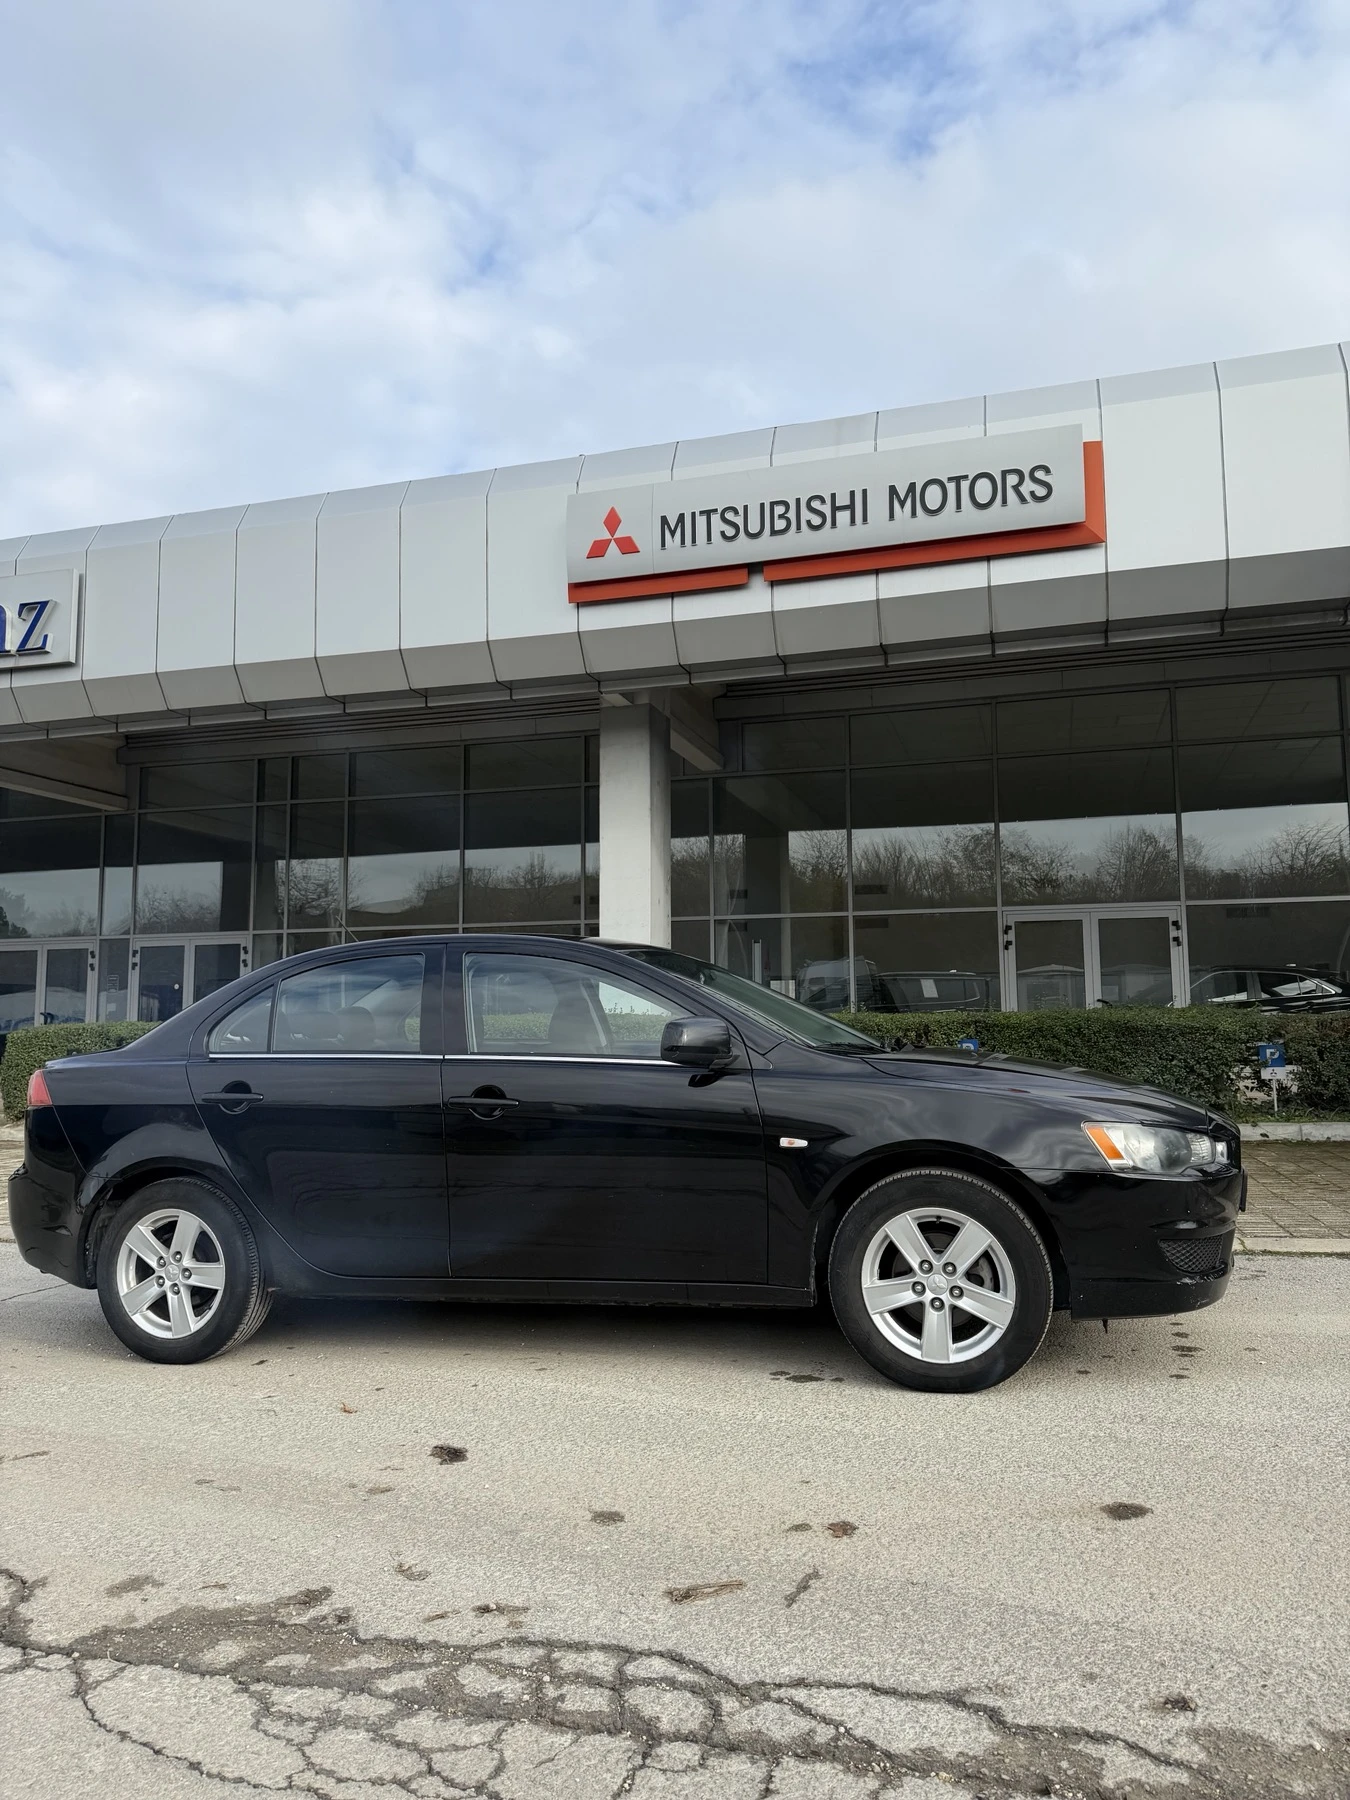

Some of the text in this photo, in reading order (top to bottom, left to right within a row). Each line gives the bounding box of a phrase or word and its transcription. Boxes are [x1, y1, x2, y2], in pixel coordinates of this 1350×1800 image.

[660, 464, 1053, 550] MITSUBISHI MOTORS
[0, 599, 53, 654] z
[1266, 1048, 1280, 1067] P
